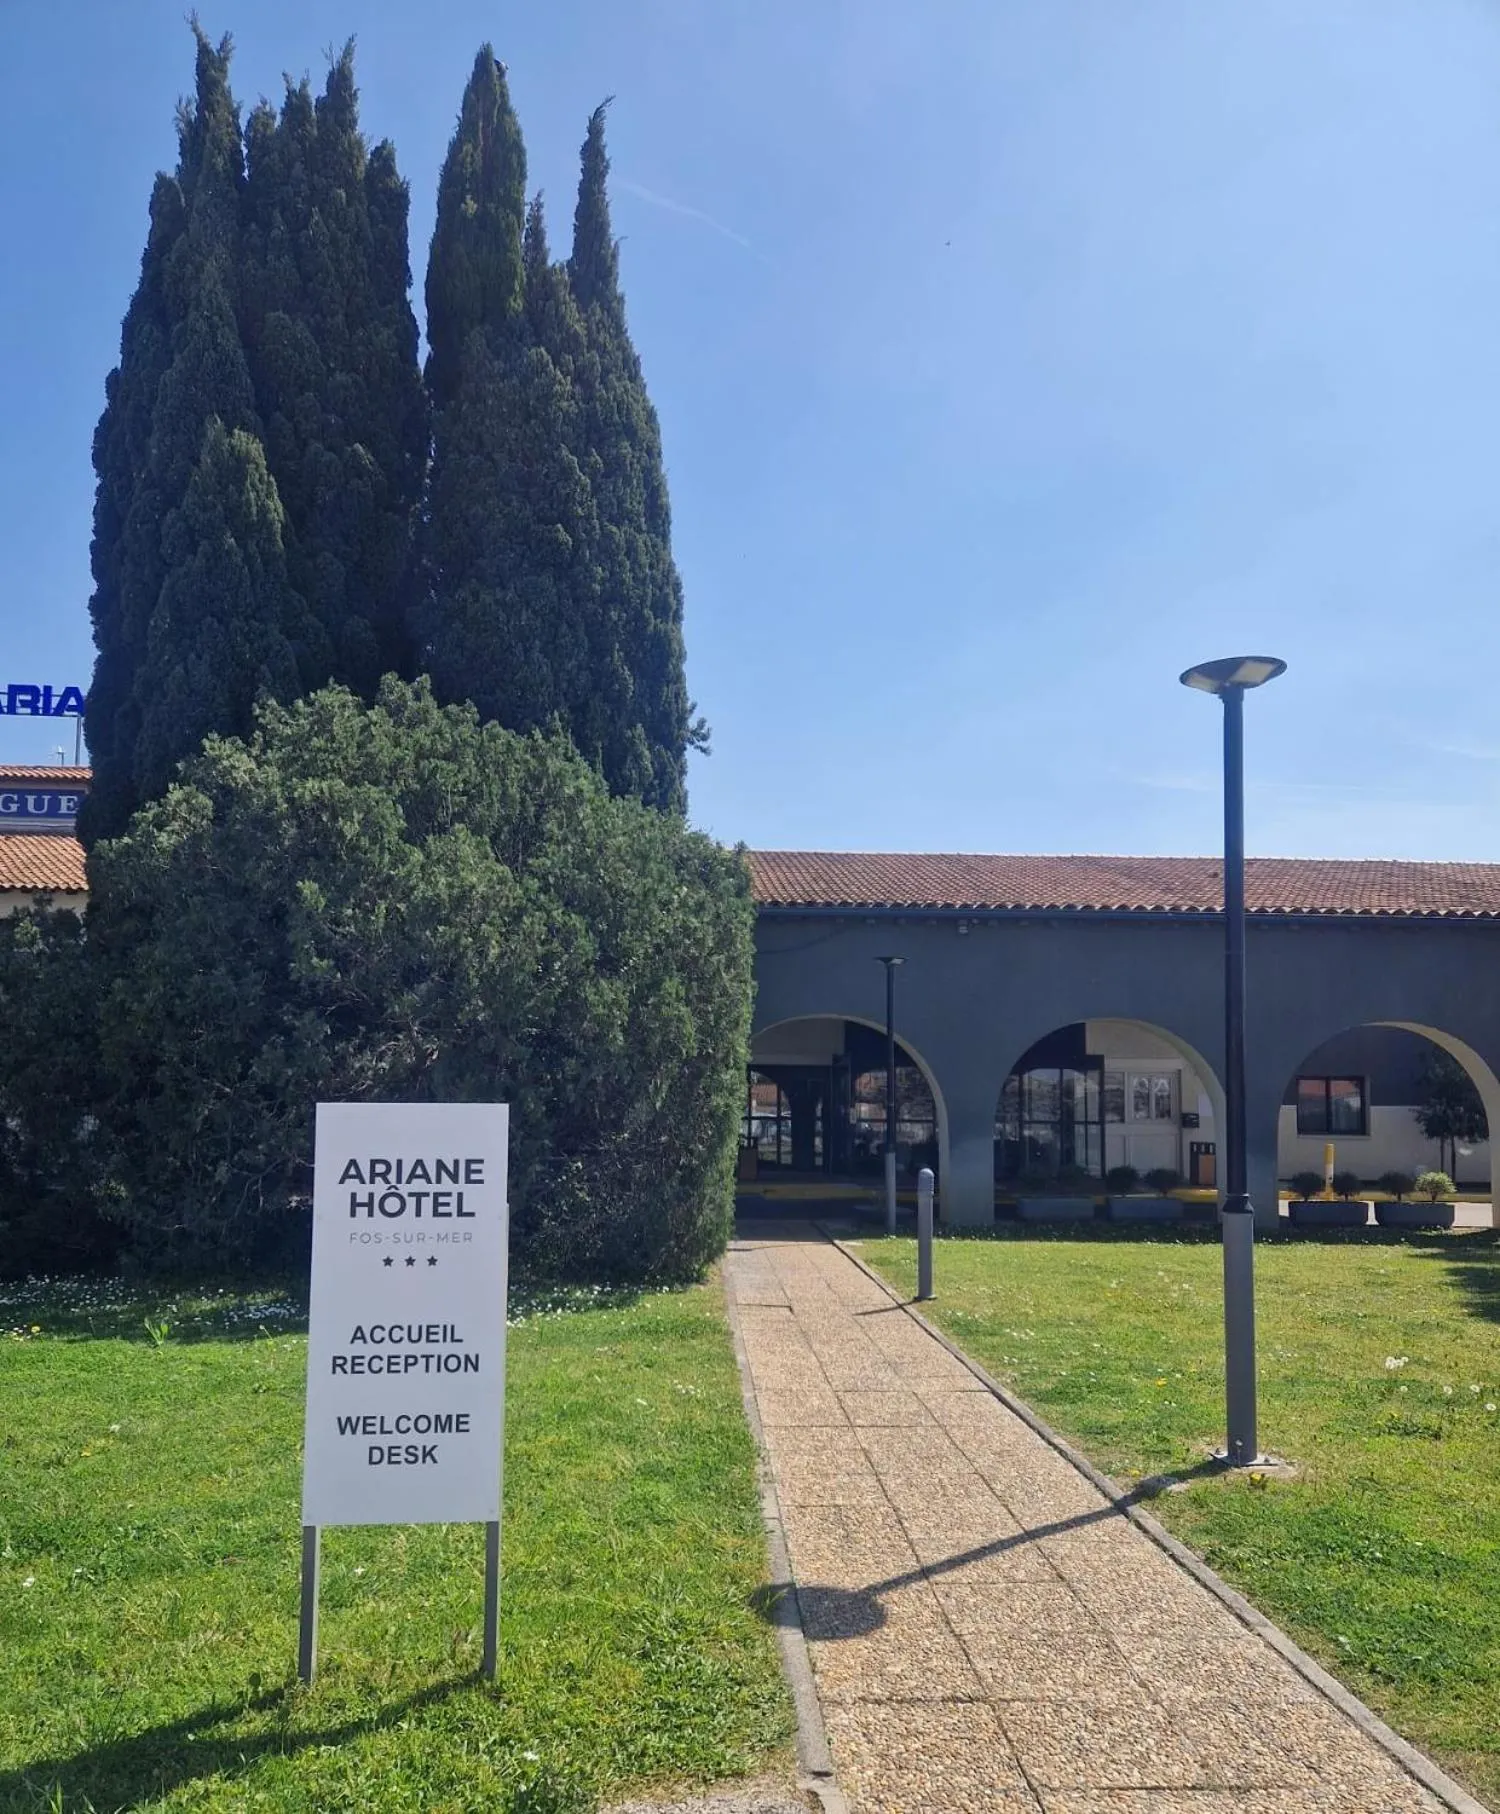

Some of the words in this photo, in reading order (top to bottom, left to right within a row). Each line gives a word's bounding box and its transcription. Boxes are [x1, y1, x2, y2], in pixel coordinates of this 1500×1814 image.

[0, 684, 84, 716] RIA
[338, 1158, 485, 1185] ARIANE
[349, 1185, 476, 1219] HÔTEL
[349, 1231, 473, 1245] FOS-SUR-MER
[350, 1324, 464, 1345] ACCUEIL
[331, 1353, 480, 1375] RECEPTION
[337, 1413, 471, 1436] WELCOME
[368, 1445, 439, 1466] DESK
